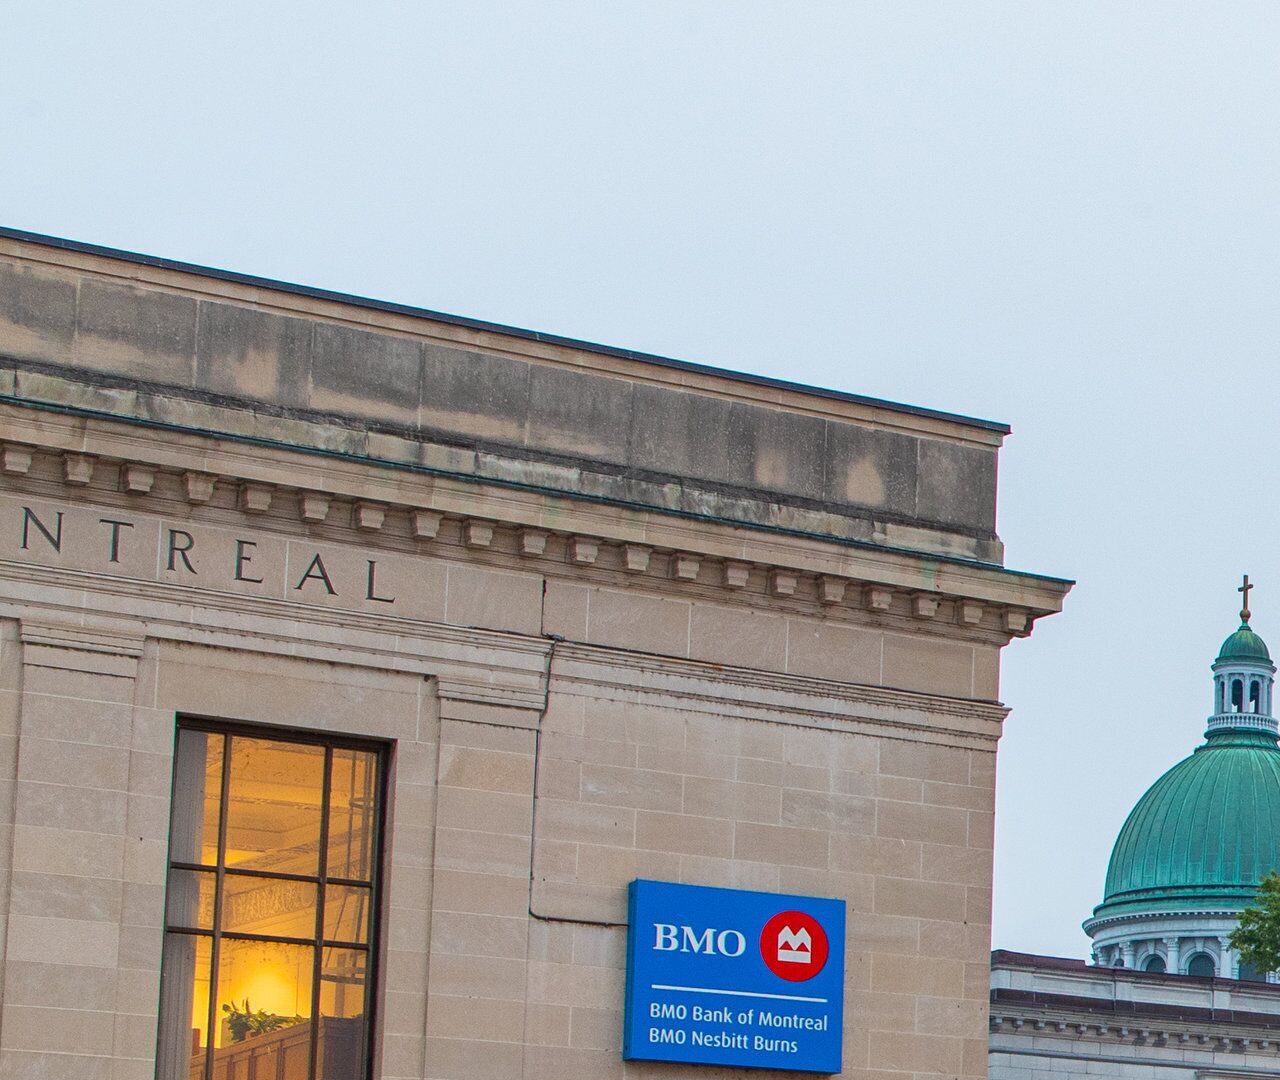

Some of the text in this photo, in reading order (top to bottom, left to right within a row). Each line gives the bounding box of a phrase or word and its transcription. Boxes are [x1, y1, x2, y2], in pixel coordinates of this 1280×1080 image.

[20, 506, 396, 604] NTREAL
[652, 923, 746, 957] BMO
[650, 1003, 828, 1031] BMO Bank of Montreal
[649, 1027, 798, 1053] BMO Nesbitt Burns
